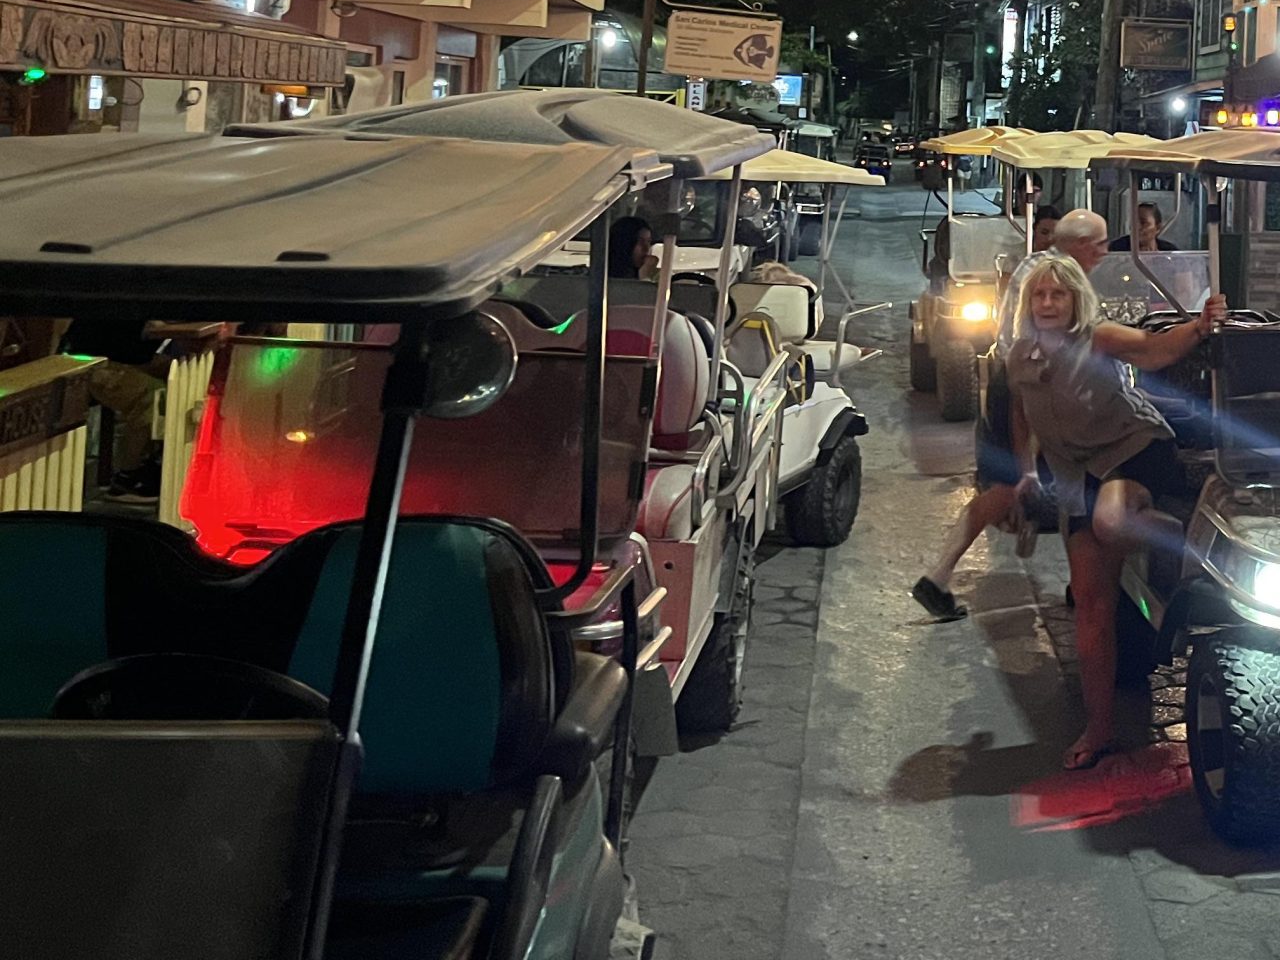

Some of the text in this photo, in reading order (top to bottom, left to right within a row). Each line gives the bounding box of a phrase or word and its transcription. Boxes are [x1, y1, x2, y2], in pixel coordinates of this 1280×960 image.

[675, 15, 690, 24] San
[692, 16, 717, 26] Carlos
[719, 19, 748, 29] Medical
